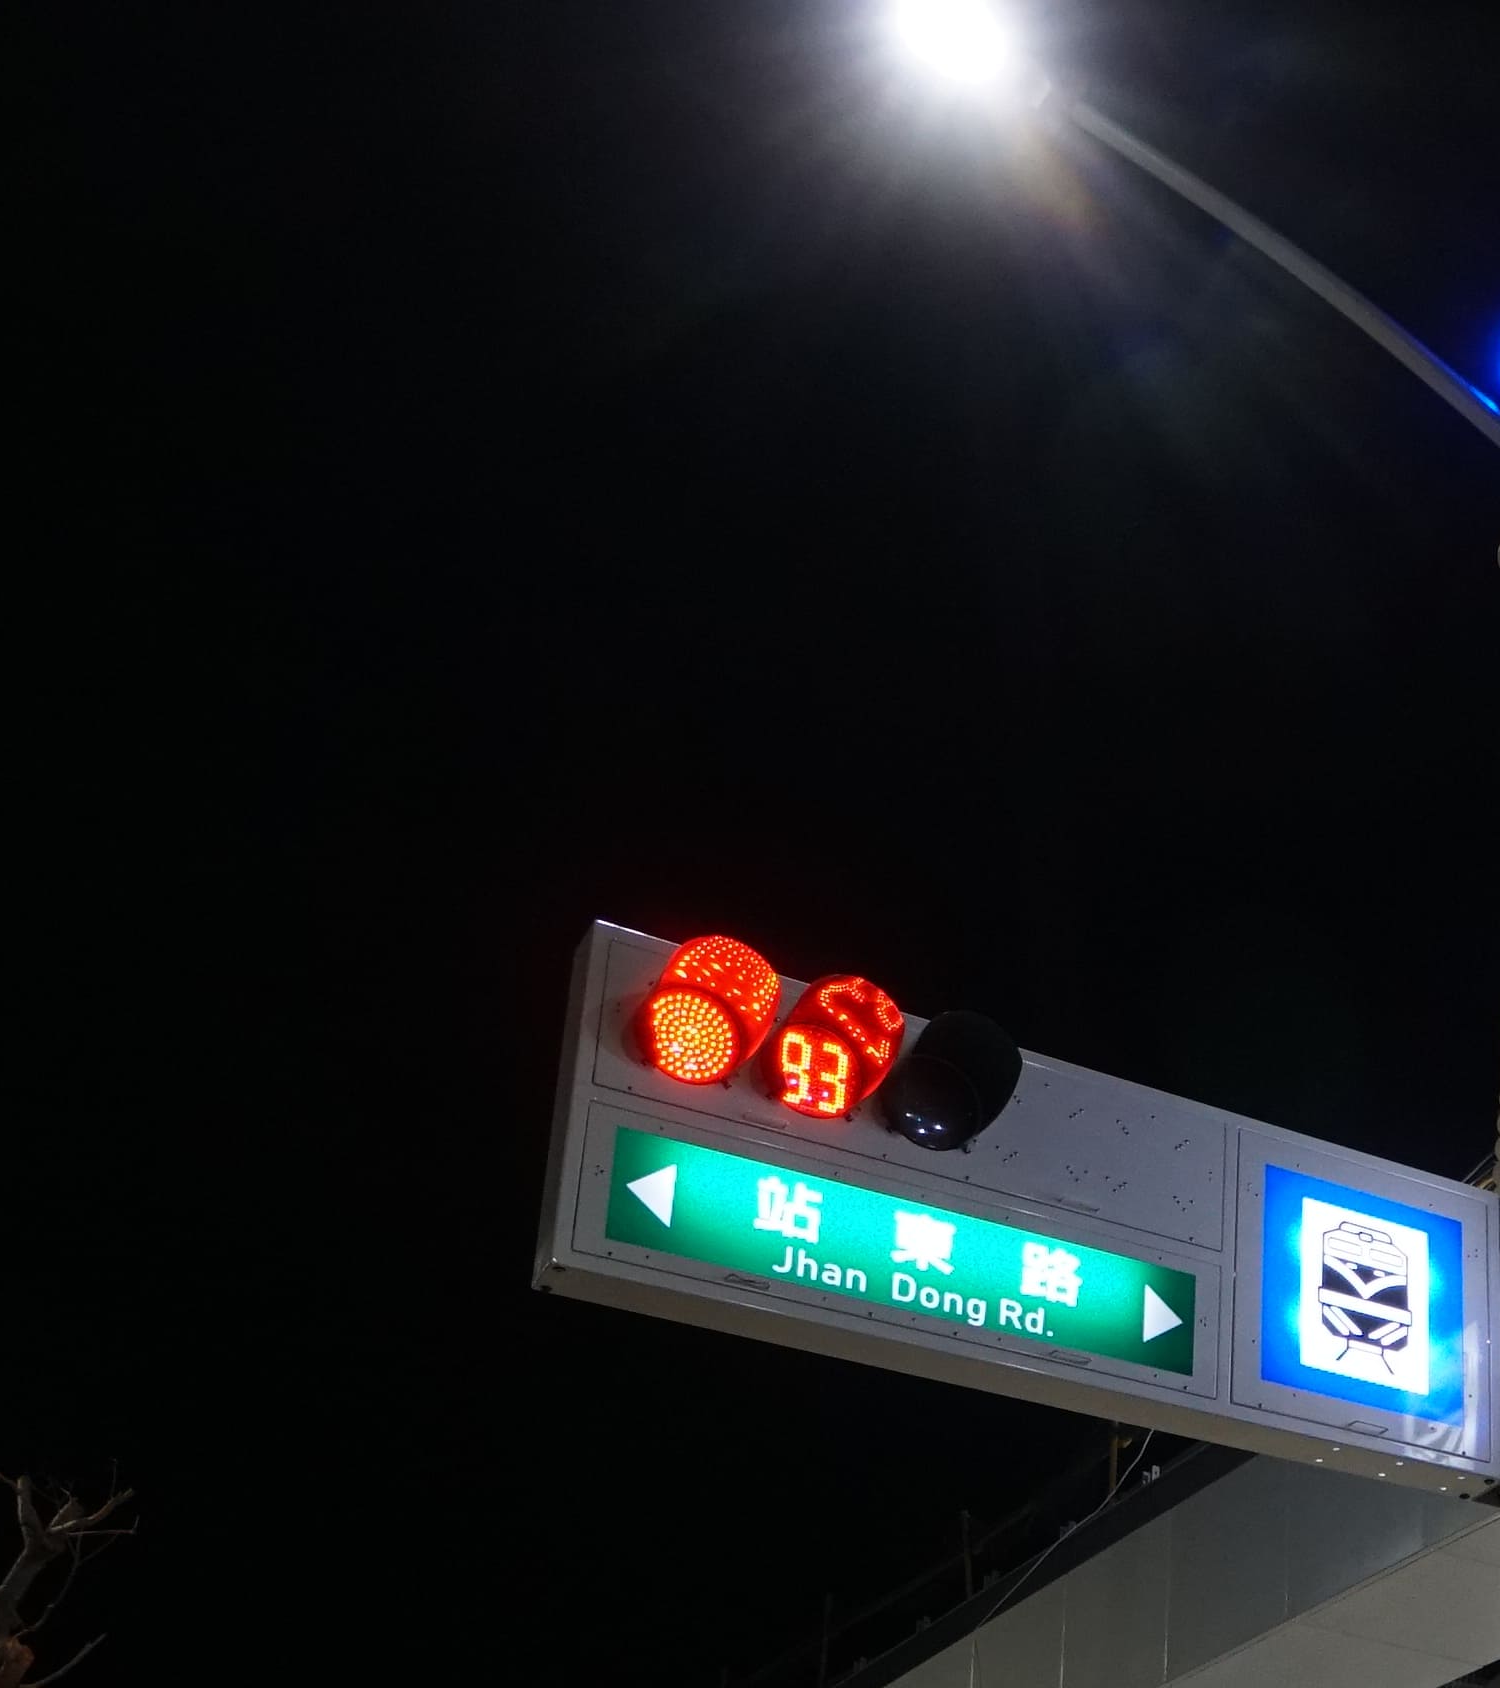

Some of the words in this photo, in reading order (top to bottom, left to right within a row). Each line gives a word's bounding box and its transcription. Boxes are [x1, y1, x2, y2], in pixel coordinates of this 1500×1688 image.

[782, 1031, 848, 1114] 93
[753, 1176, 1083, 1307] 站東路
[772, 1246, 867, 1292] Jhan
[891, 1272, 987, 1327] Dong
[999, 1298, 1054, 1337] Rd.
